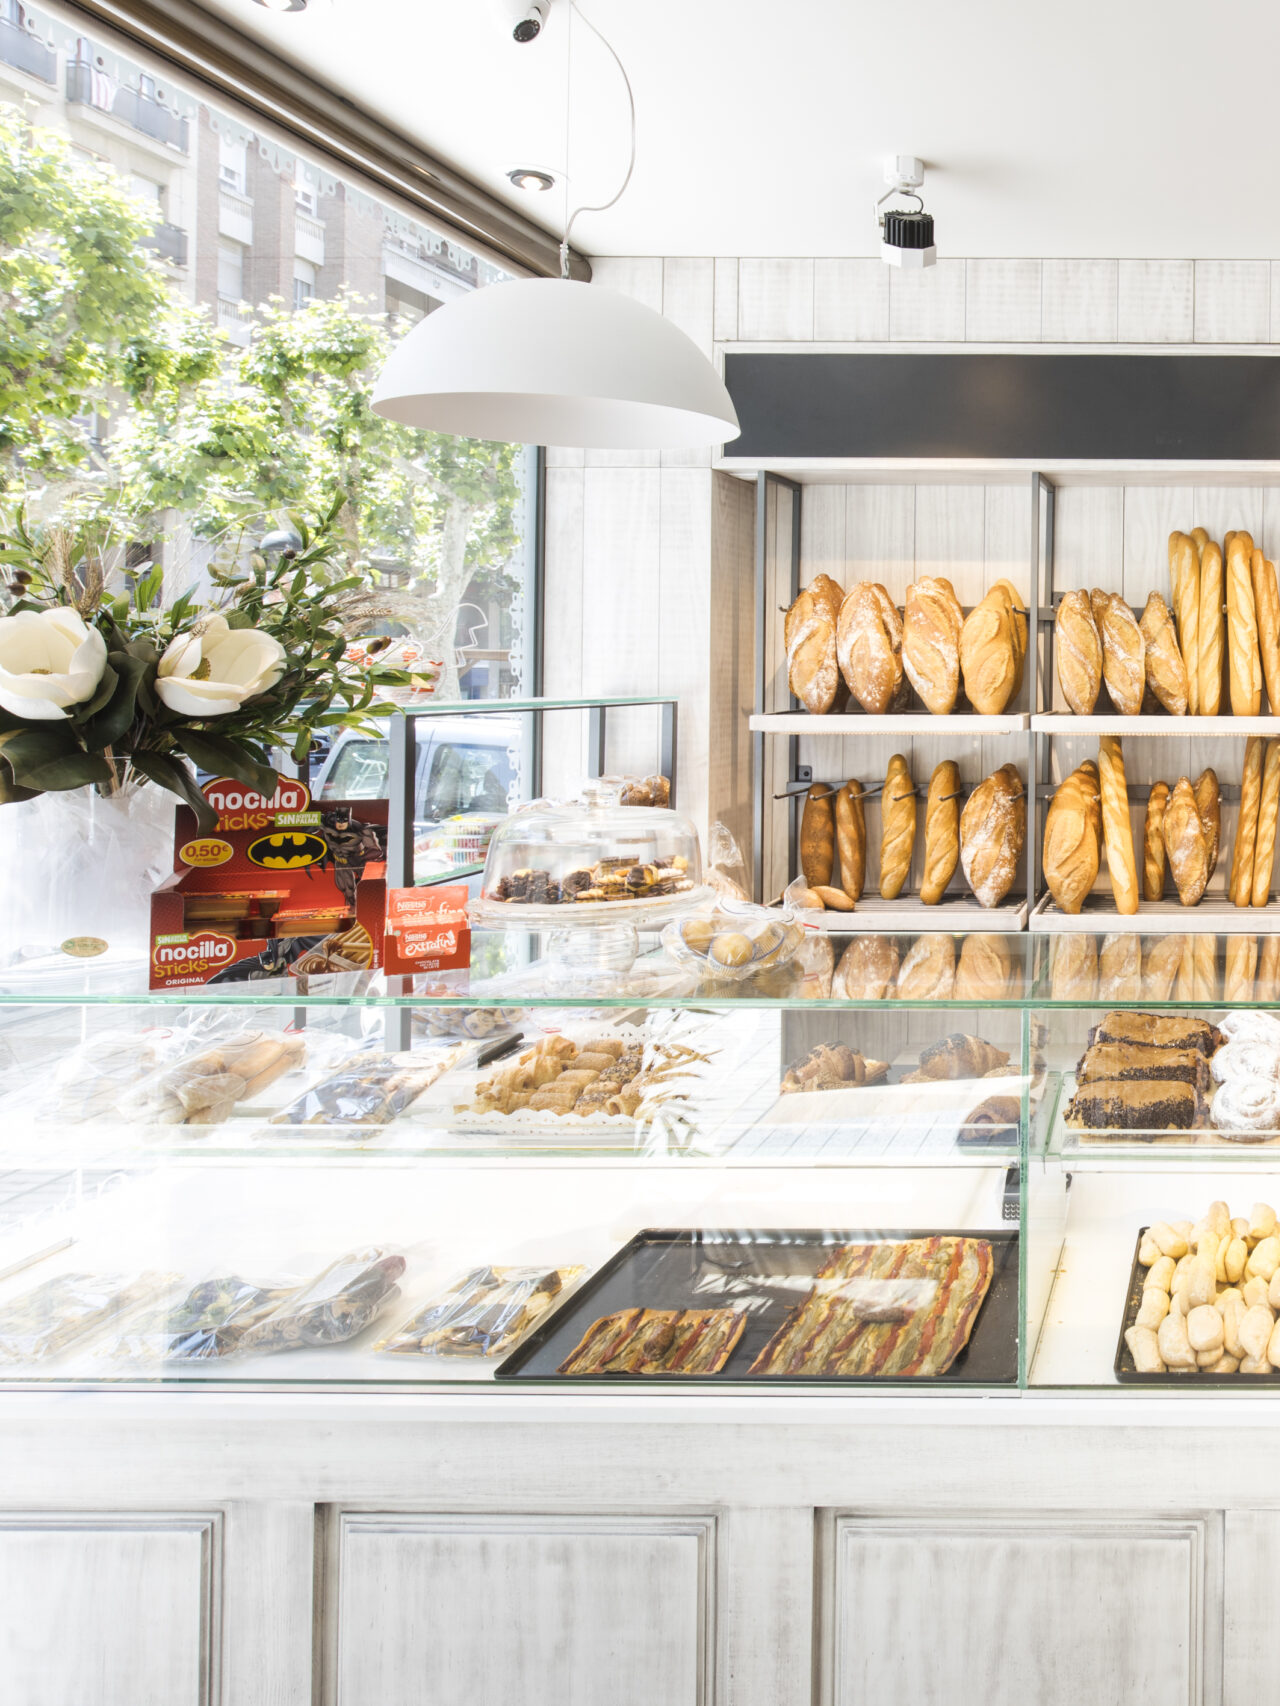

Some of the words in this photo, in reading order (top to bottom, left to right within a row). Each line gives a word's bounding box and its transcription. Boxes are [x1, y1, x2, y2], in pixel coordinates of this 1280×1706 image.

[278, 814, 296, 825] SIN
[160, 941, 229, 962] nocilla
[165, 977, 205, 986] ORIGINAL
